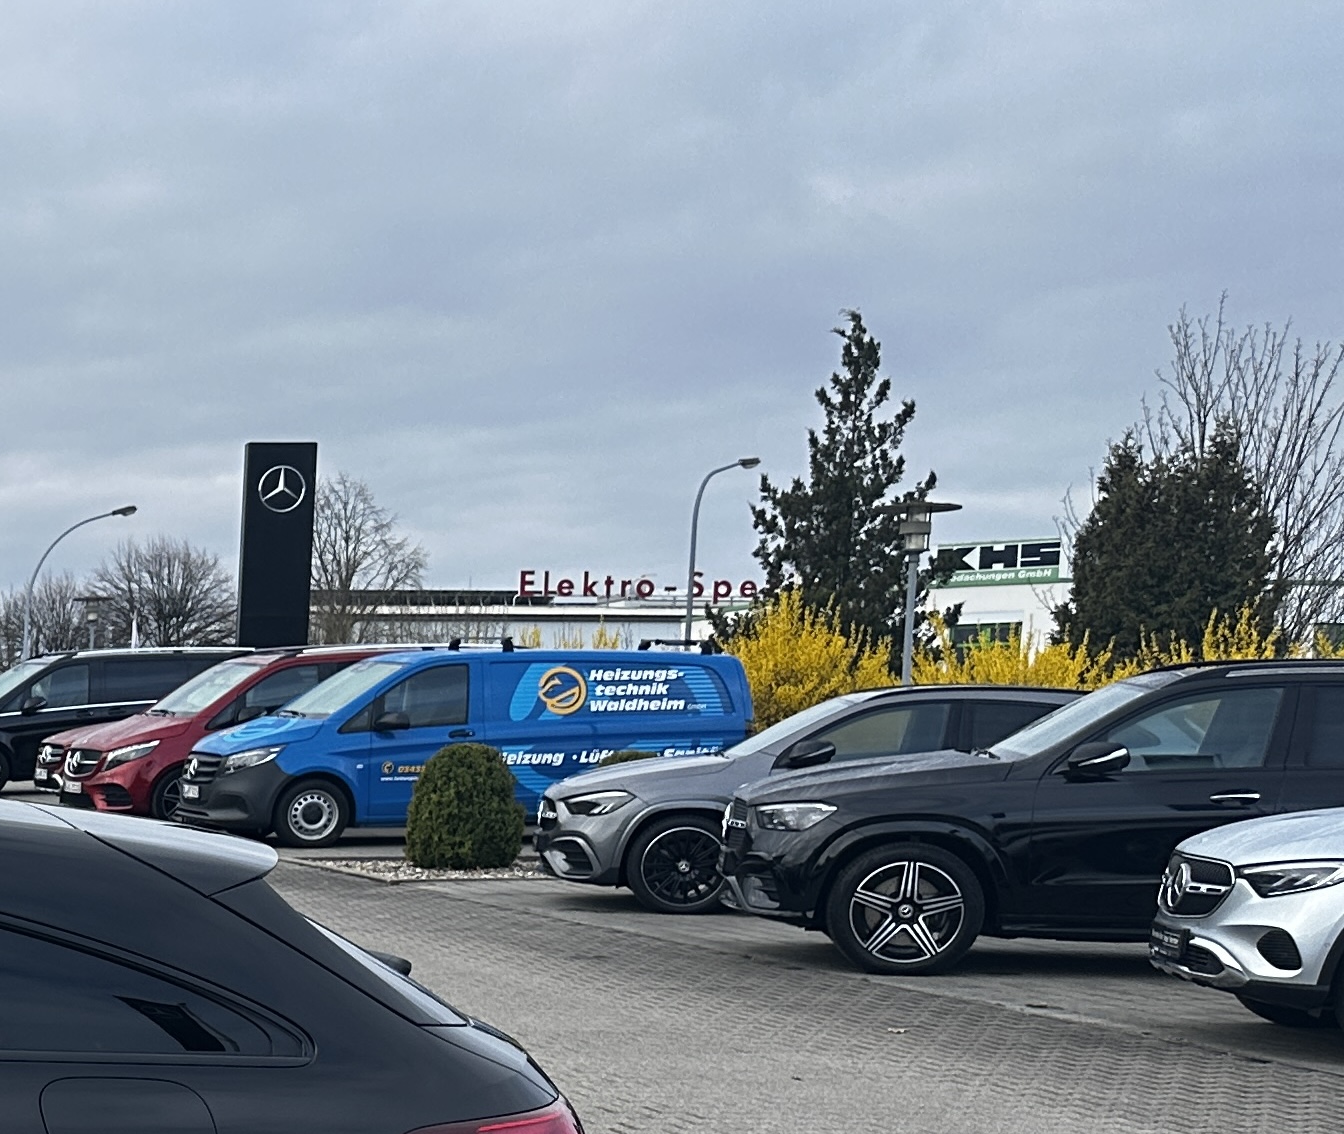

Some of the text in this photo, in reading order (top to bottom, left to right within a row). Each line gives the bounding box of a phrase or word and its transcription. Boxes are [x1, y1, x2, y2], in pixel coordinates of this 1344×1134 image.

[938, 542, 1060, 570] KHS
[1018, 569, 1051, 579] GmbH
[520, 570, 758, 604] Elektro-Spe
[589, 668, 684, 682] Heizungs-
[595, 682, 670, 696] technik
[590, 699, 685, 712] Waldheim
